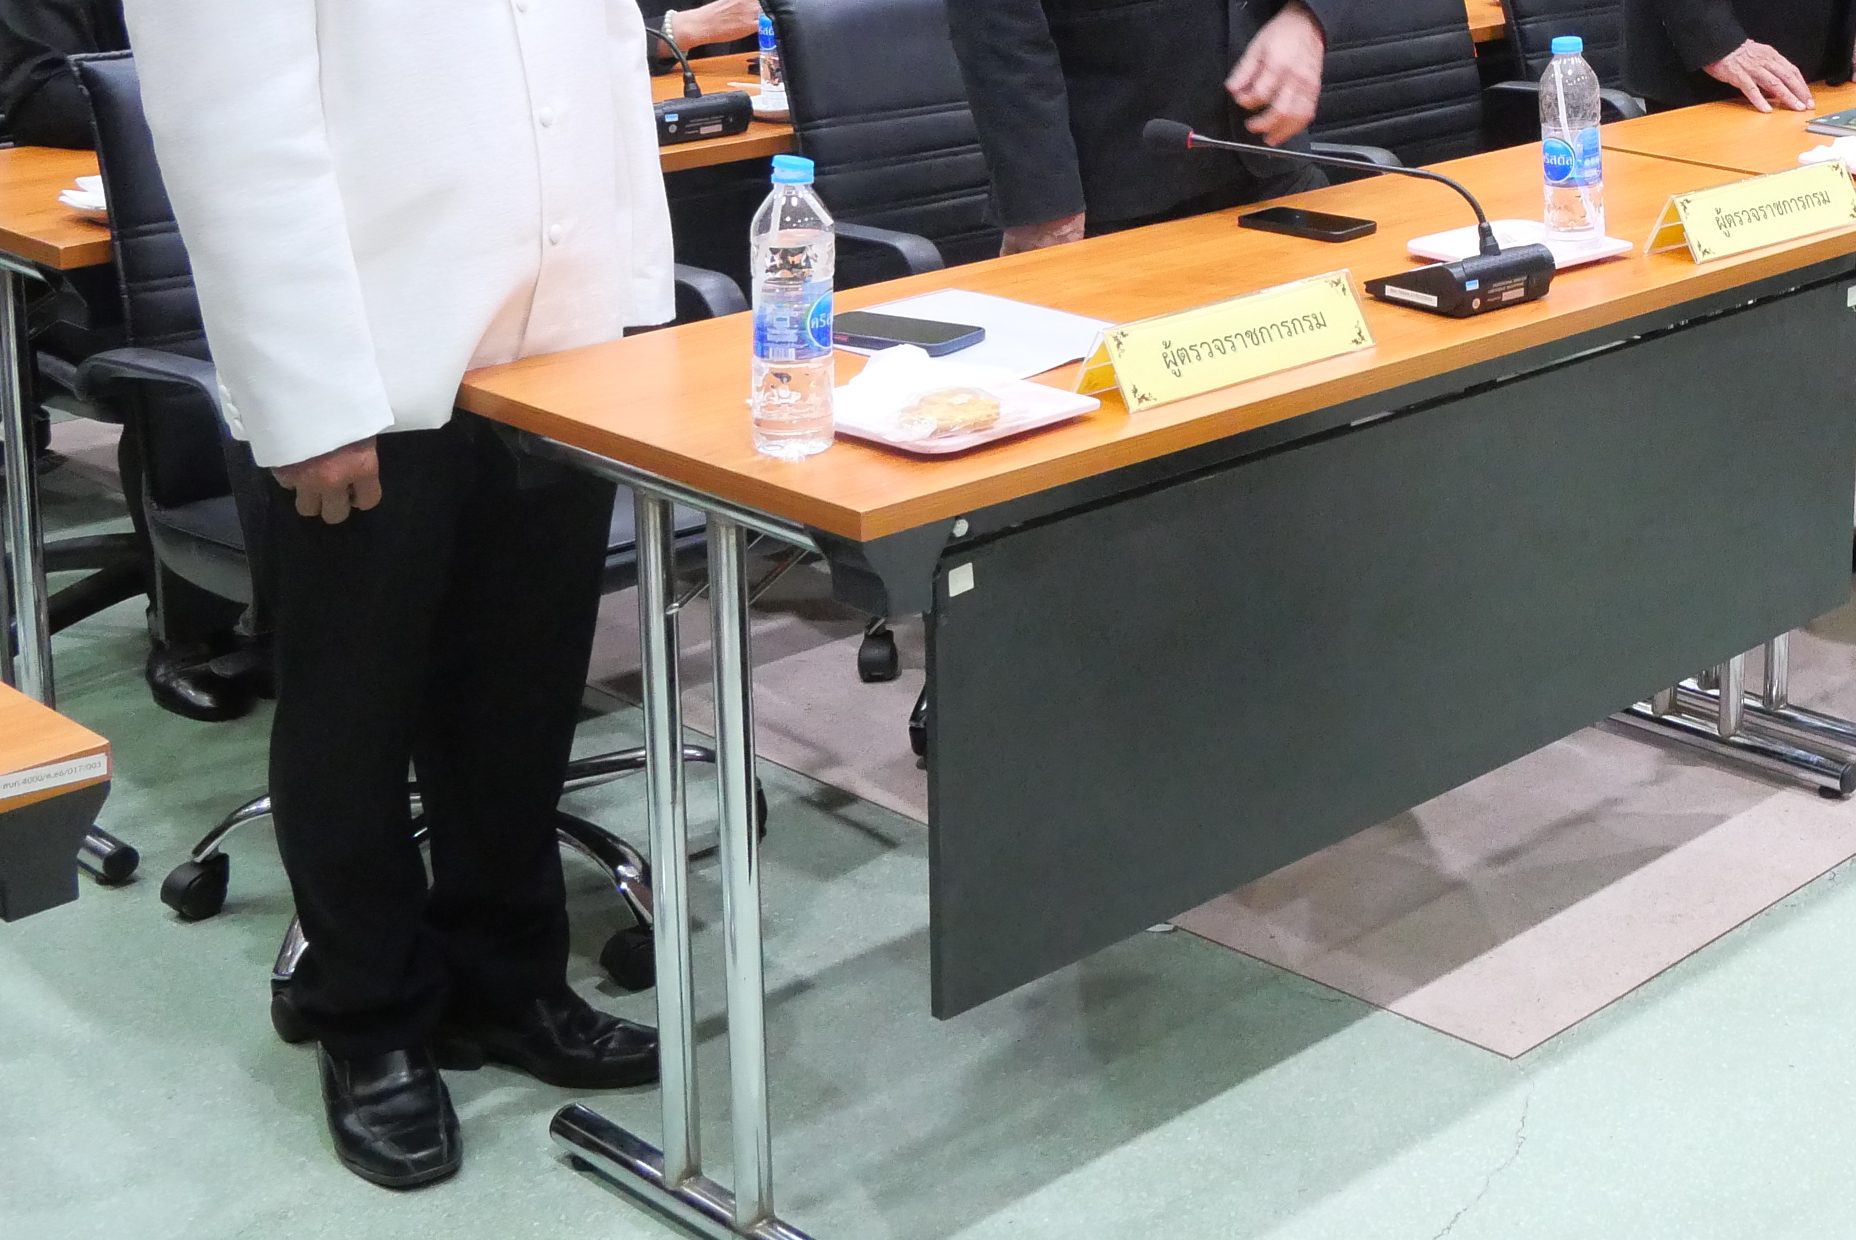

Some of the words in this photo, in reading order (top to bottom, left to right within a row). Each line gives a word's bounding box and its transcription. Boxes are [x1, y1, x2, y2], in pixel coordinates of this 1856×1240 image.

[1715, 189, 1831, 237] ผู้ตรวจราชการกรม
[1161, 310, 1327, 378] ผู้ตรวจราชการกรม
